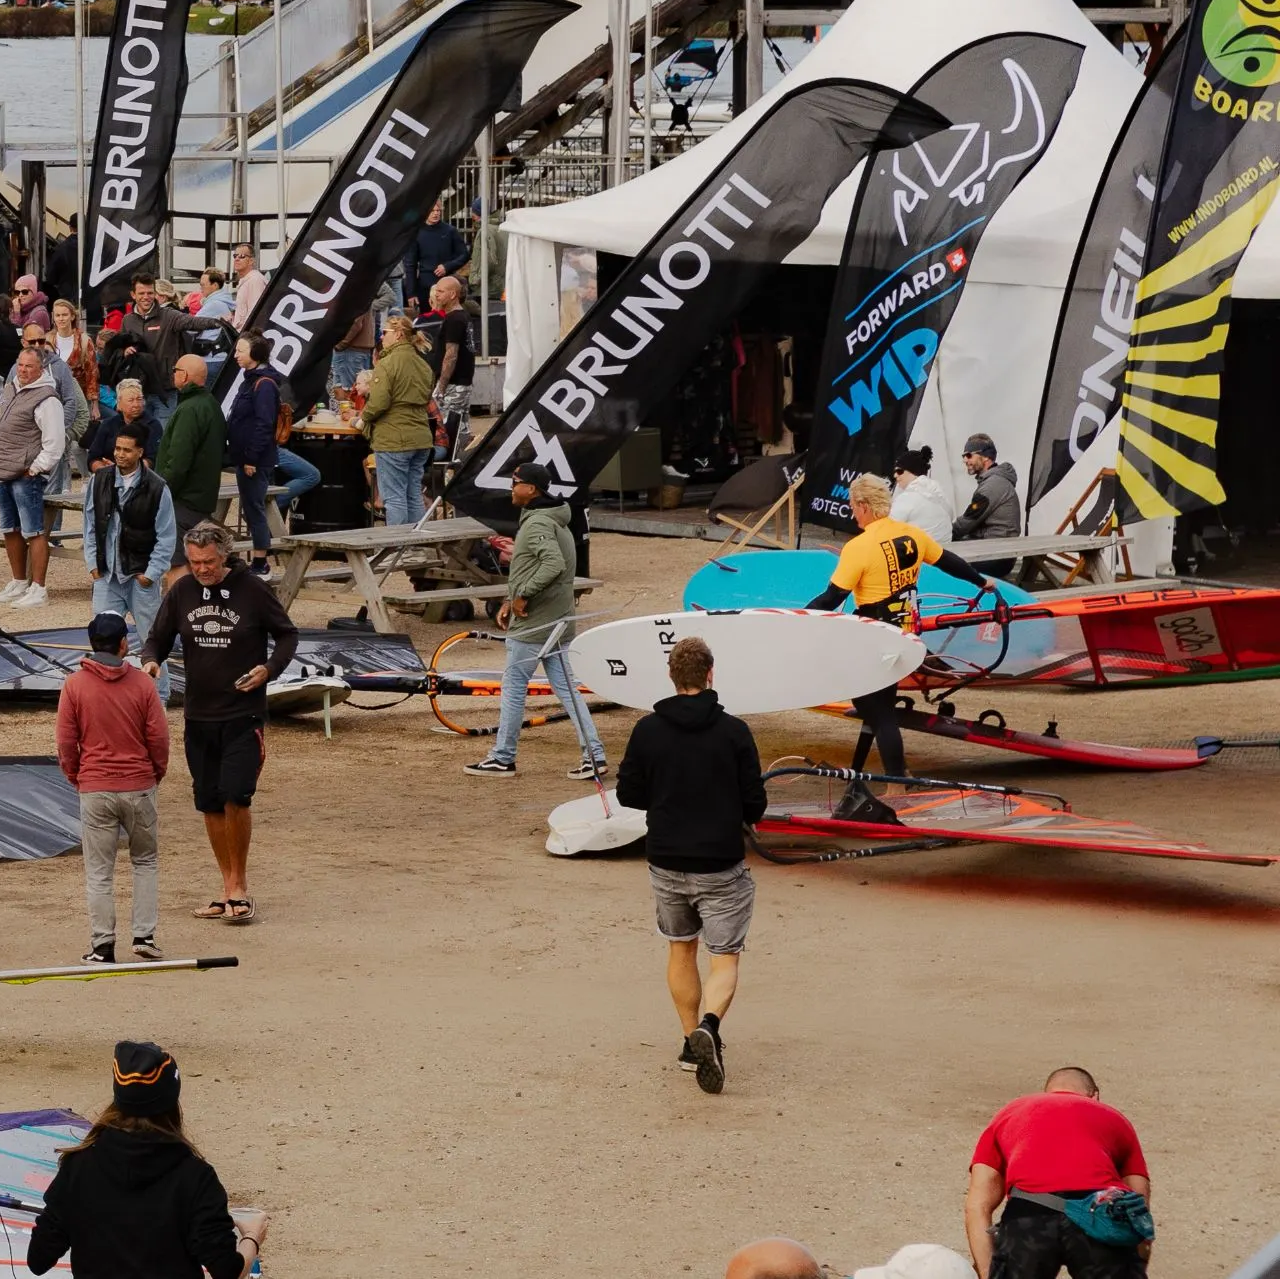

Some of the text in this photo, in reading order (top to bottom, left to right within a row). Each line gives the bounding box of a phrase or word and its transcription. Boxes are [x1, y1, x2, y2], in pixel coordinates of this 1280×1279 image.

[1193, 73, 1280, 123] BOAR
[267, 109, 431, 378] BRUNOTTI
[1167, 156, 1279, 246] WWW.INDOBOARD.NL
[538, 172, 773, 431] BRUNOTTI
[844, 261, 947, 356] FORWARD
[827, 327, 940, 437] WIP
